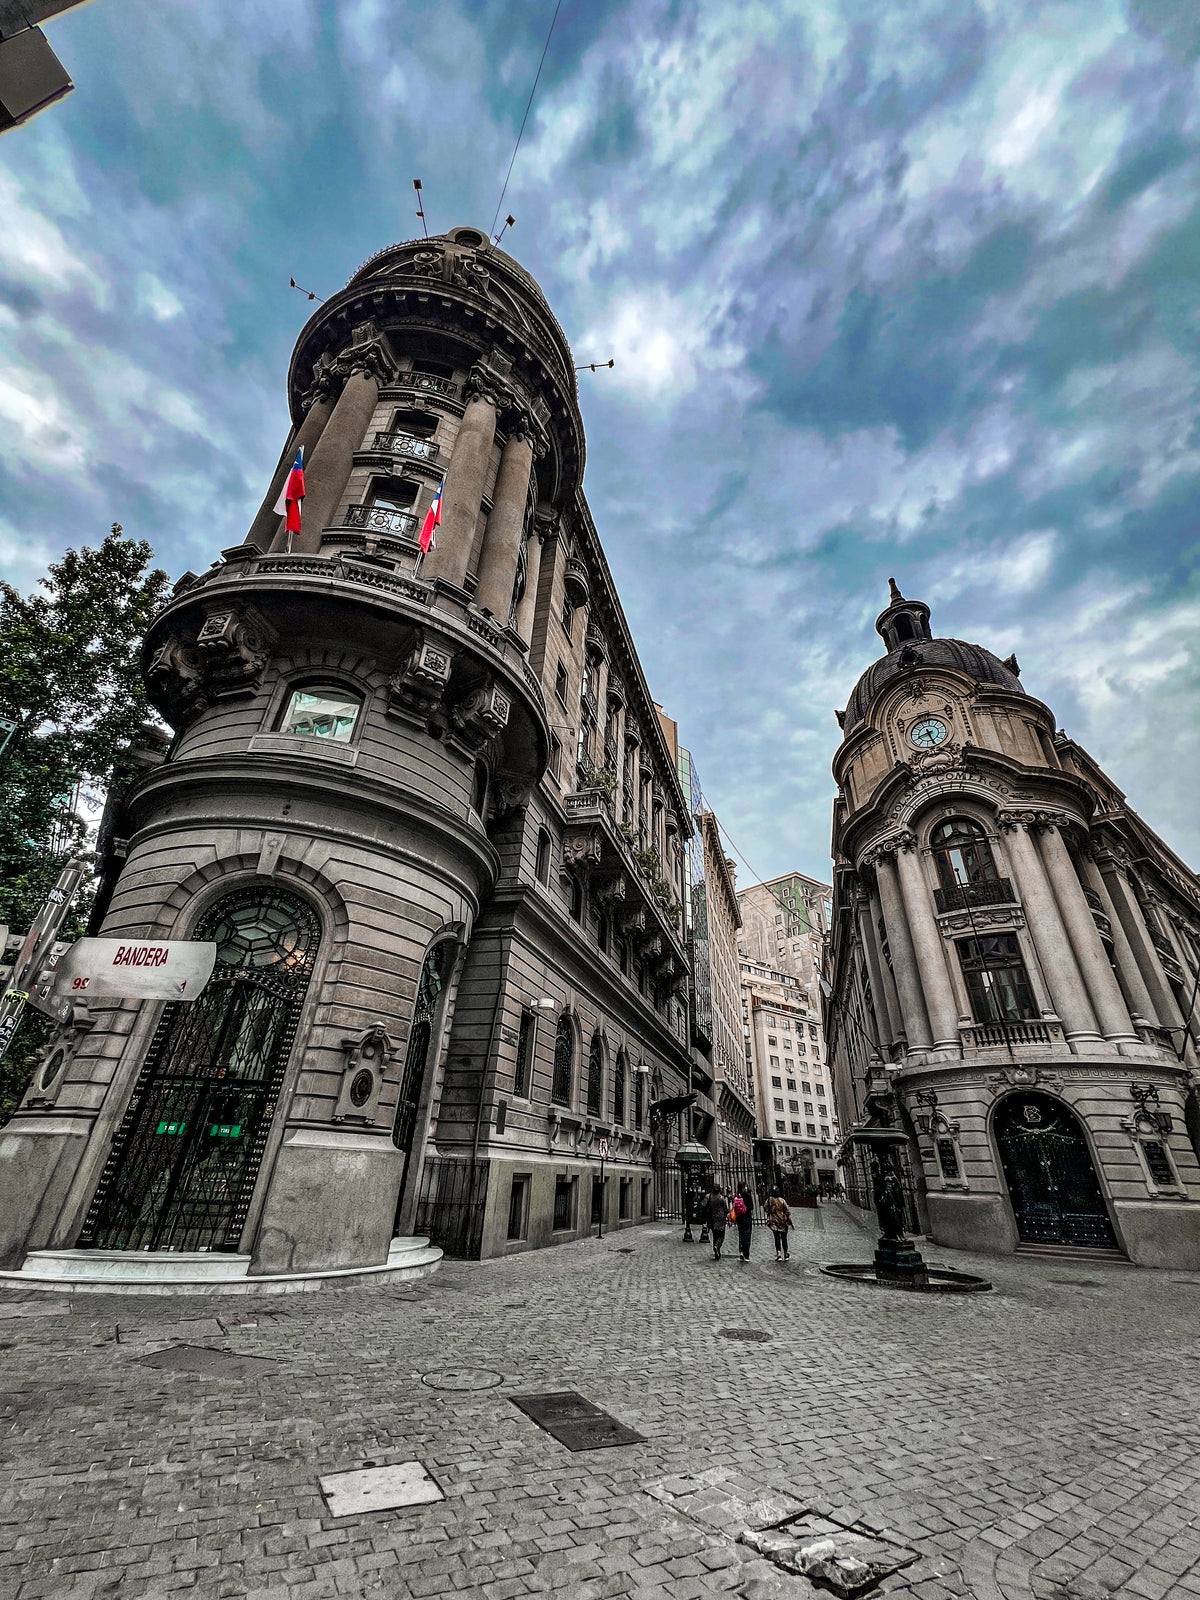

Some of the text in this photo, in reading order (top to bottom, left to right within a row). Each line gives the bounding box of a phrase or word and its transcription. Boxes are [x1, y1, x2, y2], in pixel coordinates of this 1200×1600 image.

[891, 772, 1009, 820] BOLSA DE COMERCIO
[112, 946, 169, 967] BANDERA
